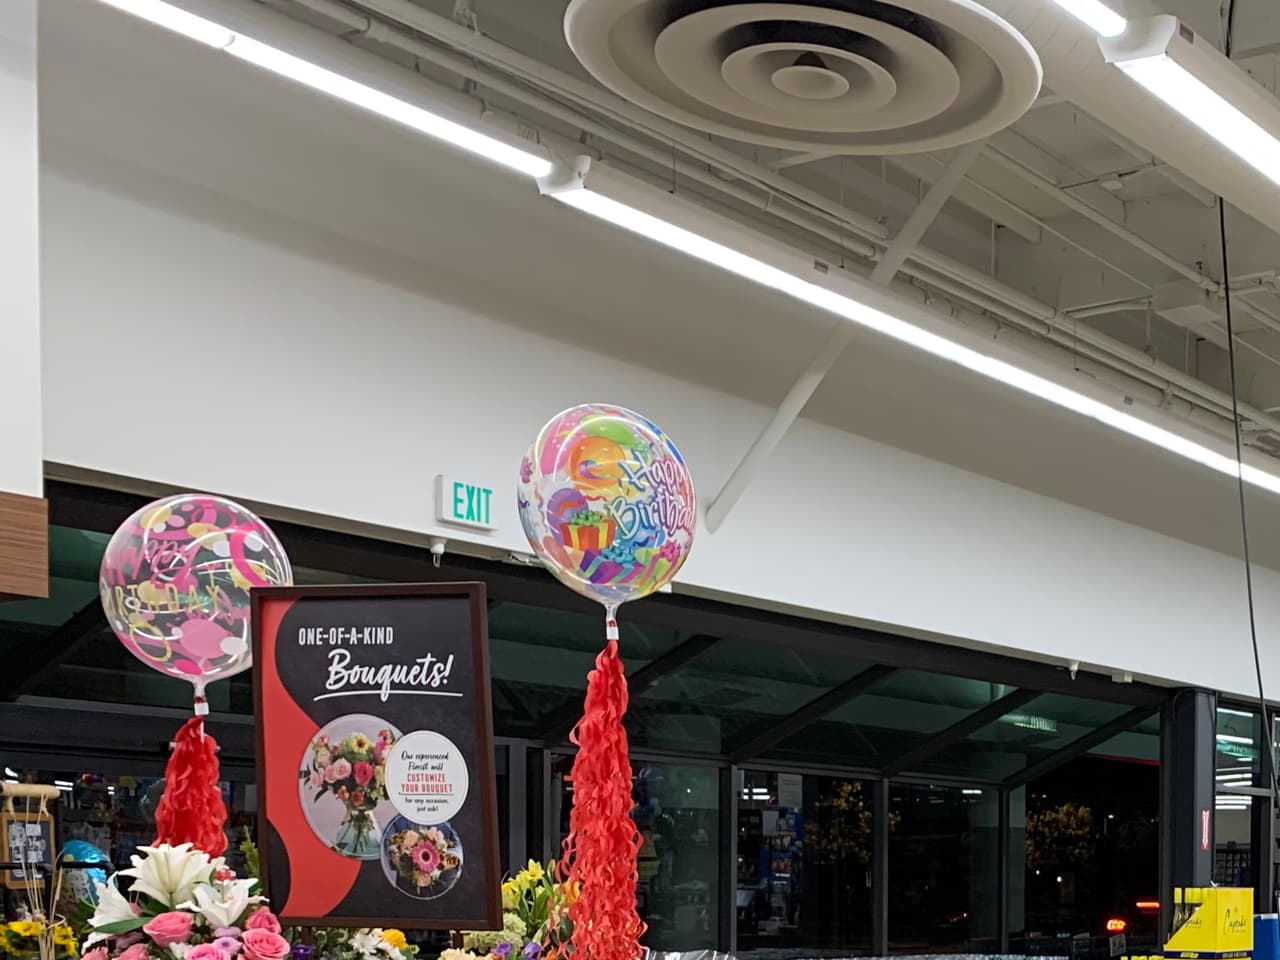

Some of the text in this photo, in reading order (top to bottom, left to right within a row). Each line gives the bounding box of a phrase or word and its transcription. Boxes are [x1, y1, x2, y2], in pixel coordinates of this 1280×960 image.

[618, 447, 686, 496] Happ
[453, 481, 493, 525] EXIT
[298, 626, 394, 646] ONE-OF-A-KIND
[325, 648, 454, 702] Bouquets!
[401, 750, 413, 760] Our
[407, 773, 446, 782] CUSTOMIZE
[401, 783, 453, 793] YOUR BOUQUET
